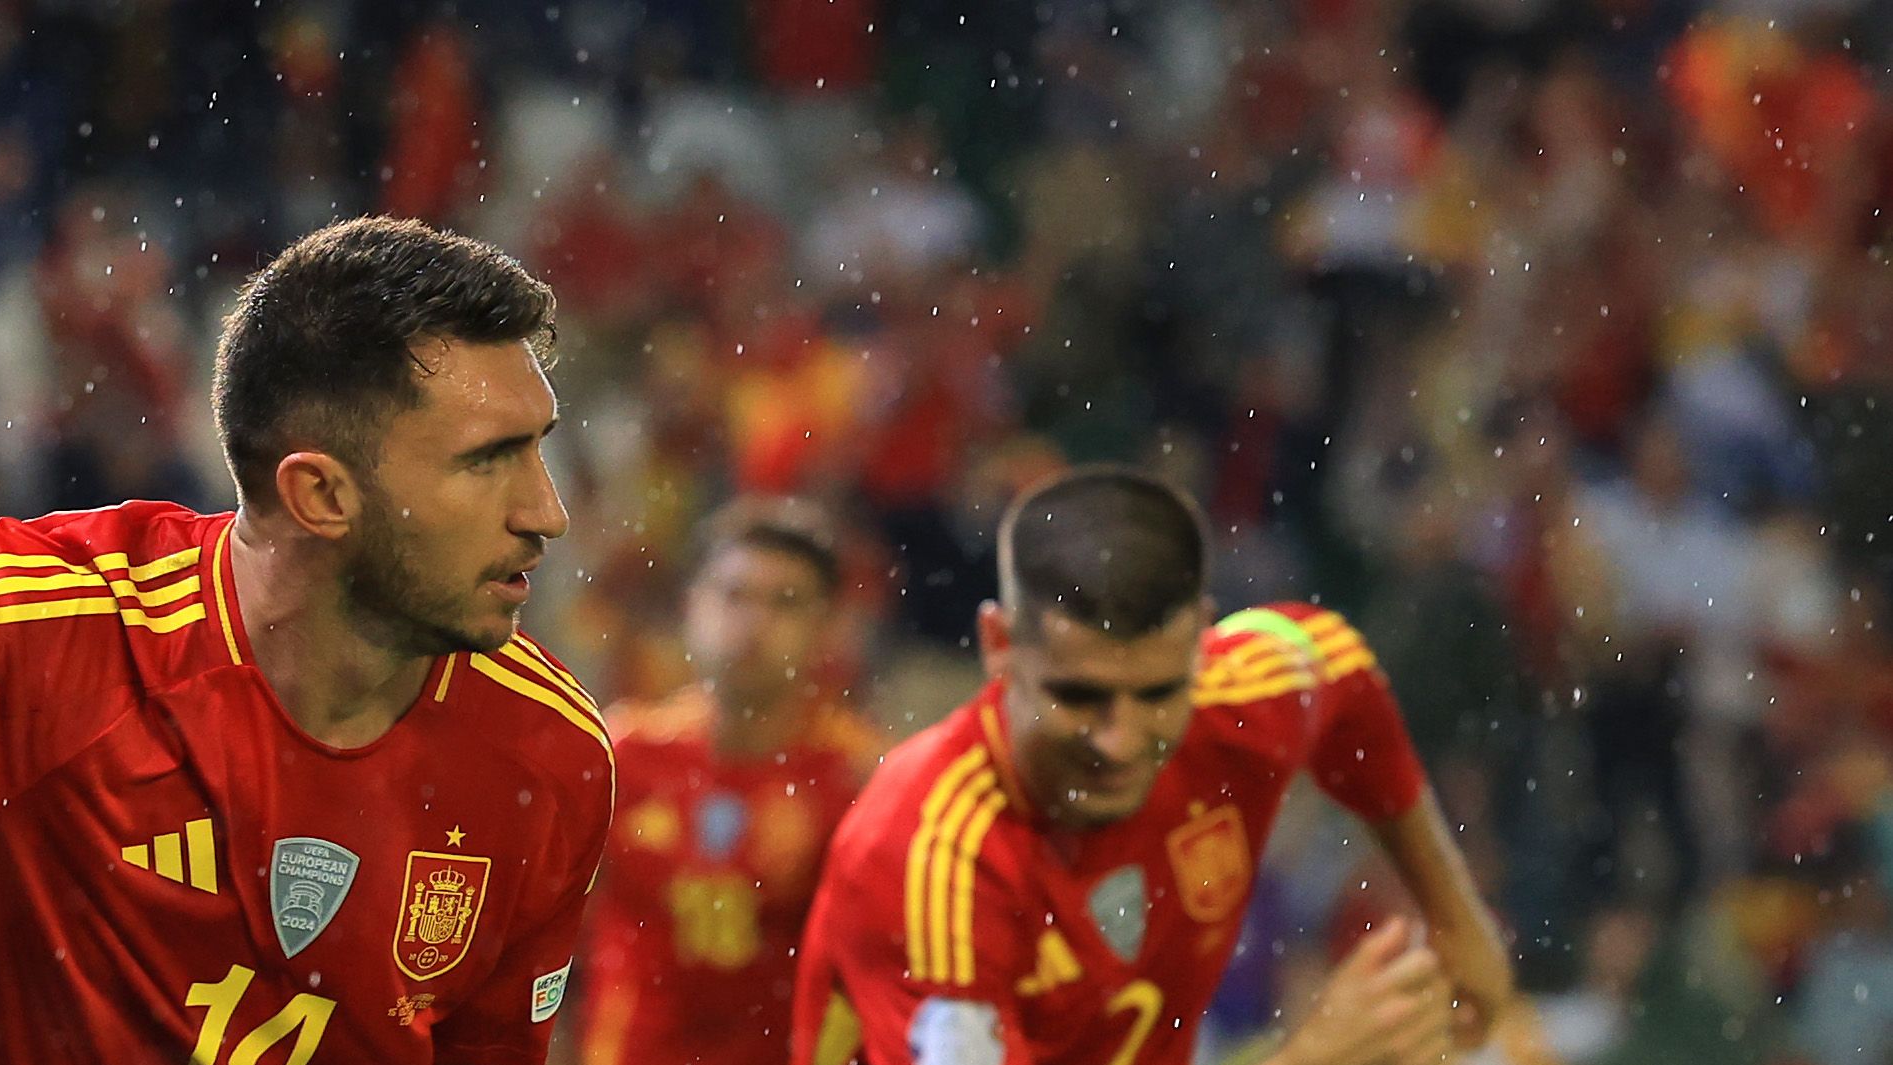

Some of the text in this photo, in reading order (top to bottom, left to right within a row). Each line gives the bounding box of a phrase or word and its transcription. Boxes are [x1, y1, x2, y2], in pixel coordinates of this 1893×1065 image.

[304, 846, 330, 858] UEFA
[281, 852, 348, 875] EUROPEAN
[278, 864, 346, 886] CHAMPIONS
[281, 915, 316, 932] 2024
[537, 974, 562, 990] UEFA
[536, 983, 565, 1007] FO
